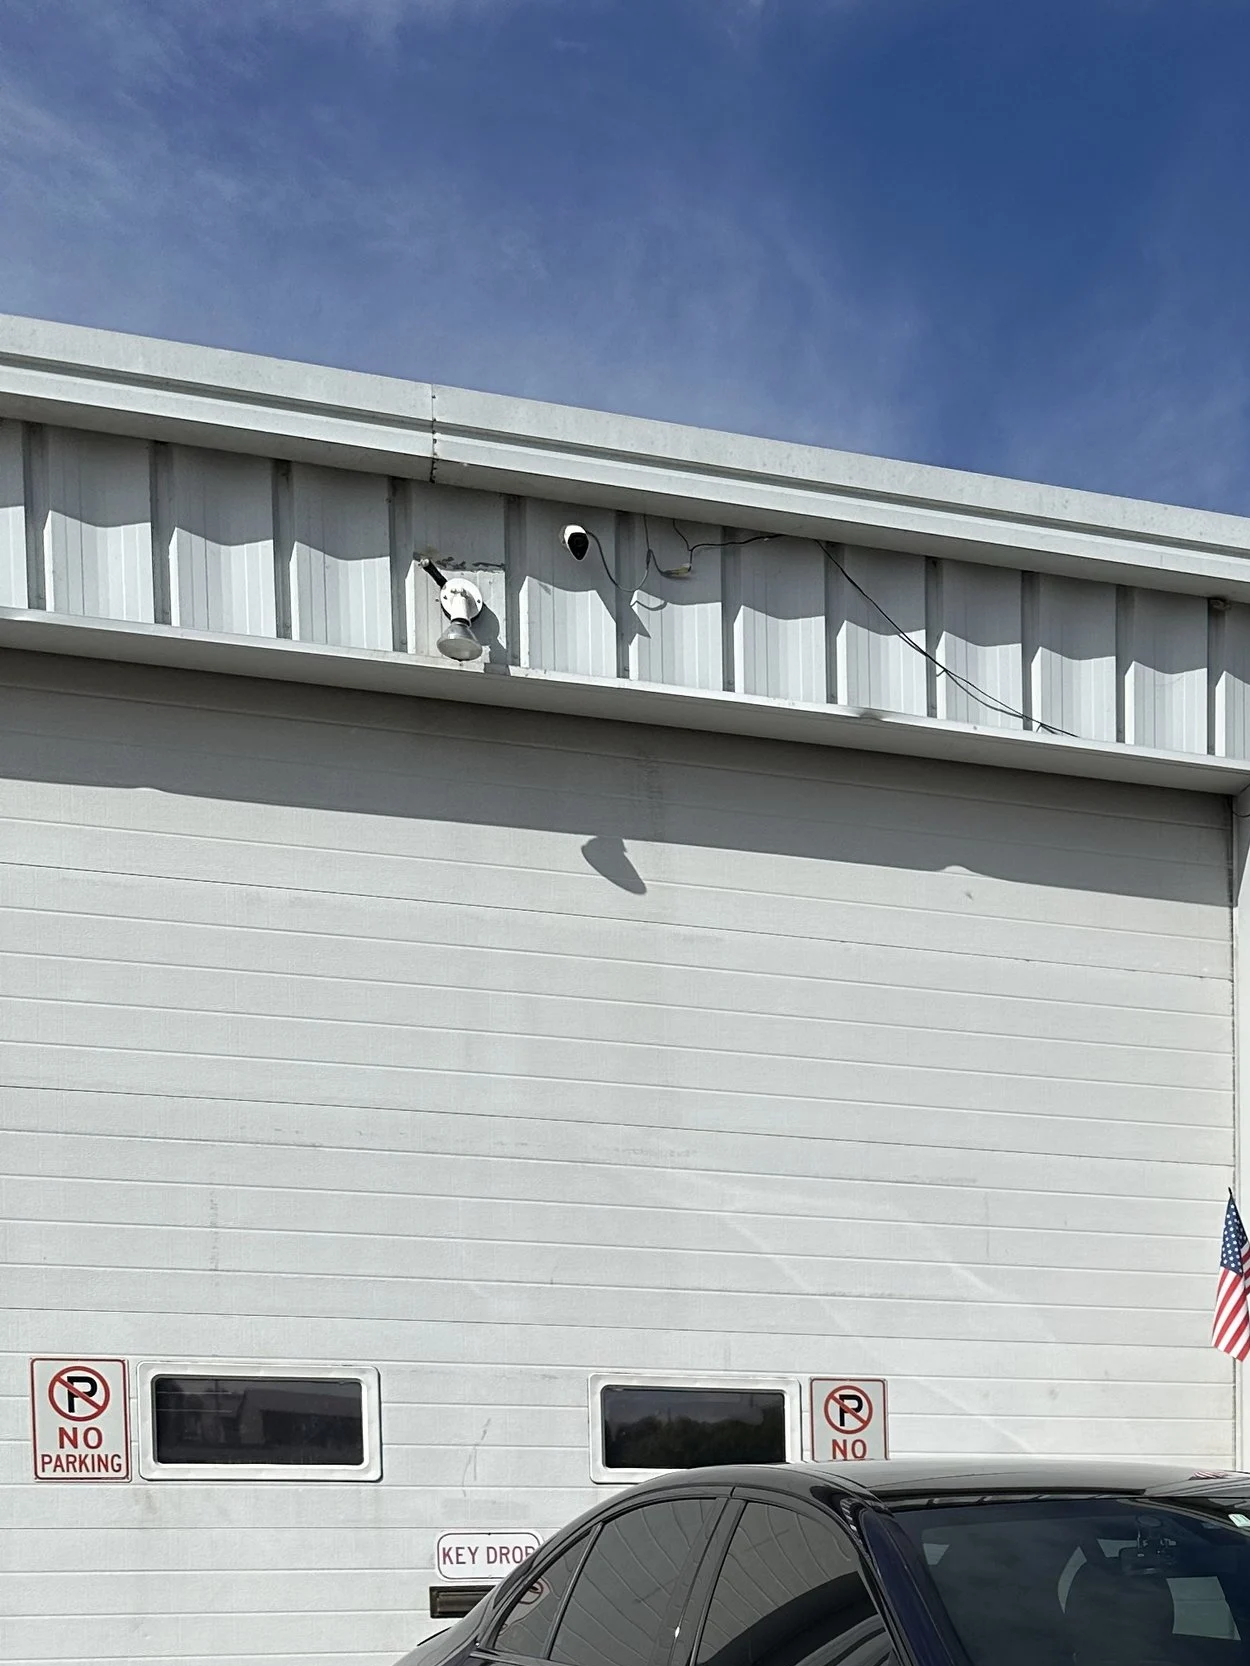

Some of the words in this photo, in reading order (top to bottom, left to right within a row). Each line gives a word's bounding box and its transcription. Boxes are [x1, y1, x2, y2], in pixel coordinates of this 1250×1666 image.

[58, 1427, 103, 1449] NO
[832, 1439, 867, 1460] NO
[41, 1454, 122, 1473] PARKING
[442, 1546, 480, 1565] KEY
